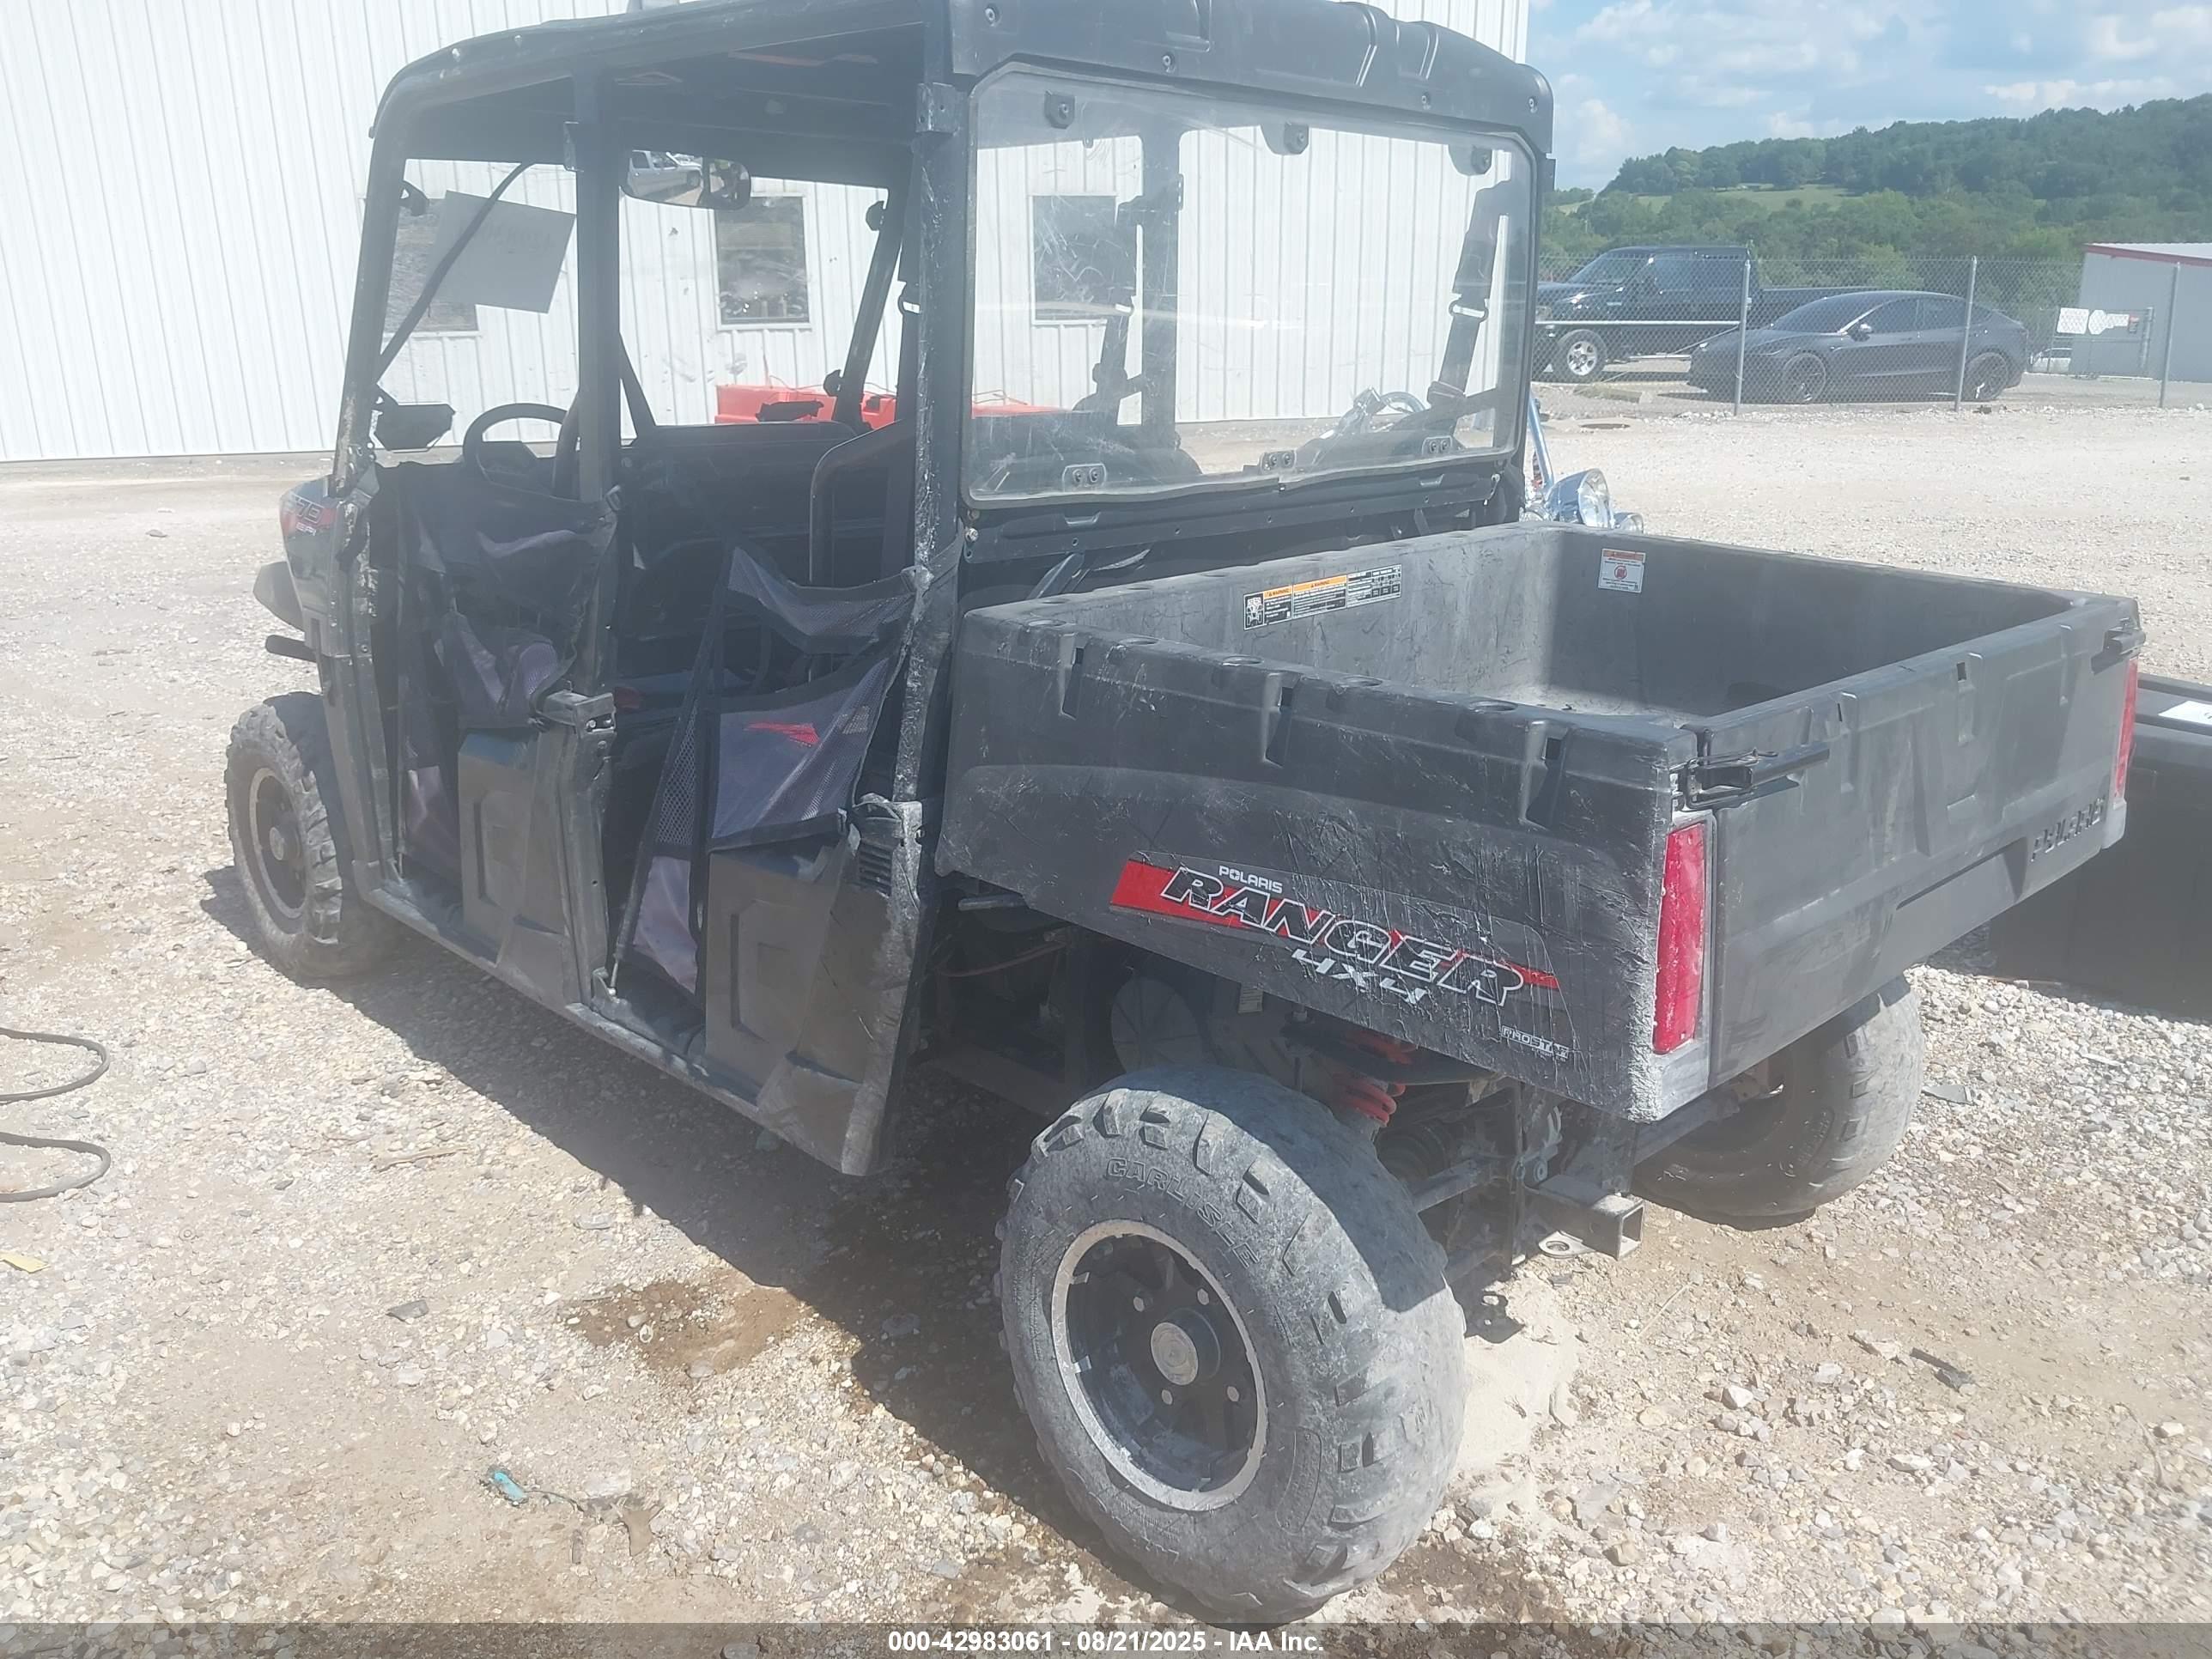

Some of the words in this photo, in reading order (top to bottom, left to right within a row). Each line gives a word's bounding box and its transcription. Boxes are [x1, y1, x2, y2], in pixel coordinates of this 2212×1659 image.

[2030, 793, 2106, 862] POLARIS
[1218, 865, 1283, 894] POLARIS
[1159, 866, 1526, 1006] RANGER
[1291, 948, 1427, 1005] 4X4
[1106, 1158, 1263, 1269] CARLISLE
